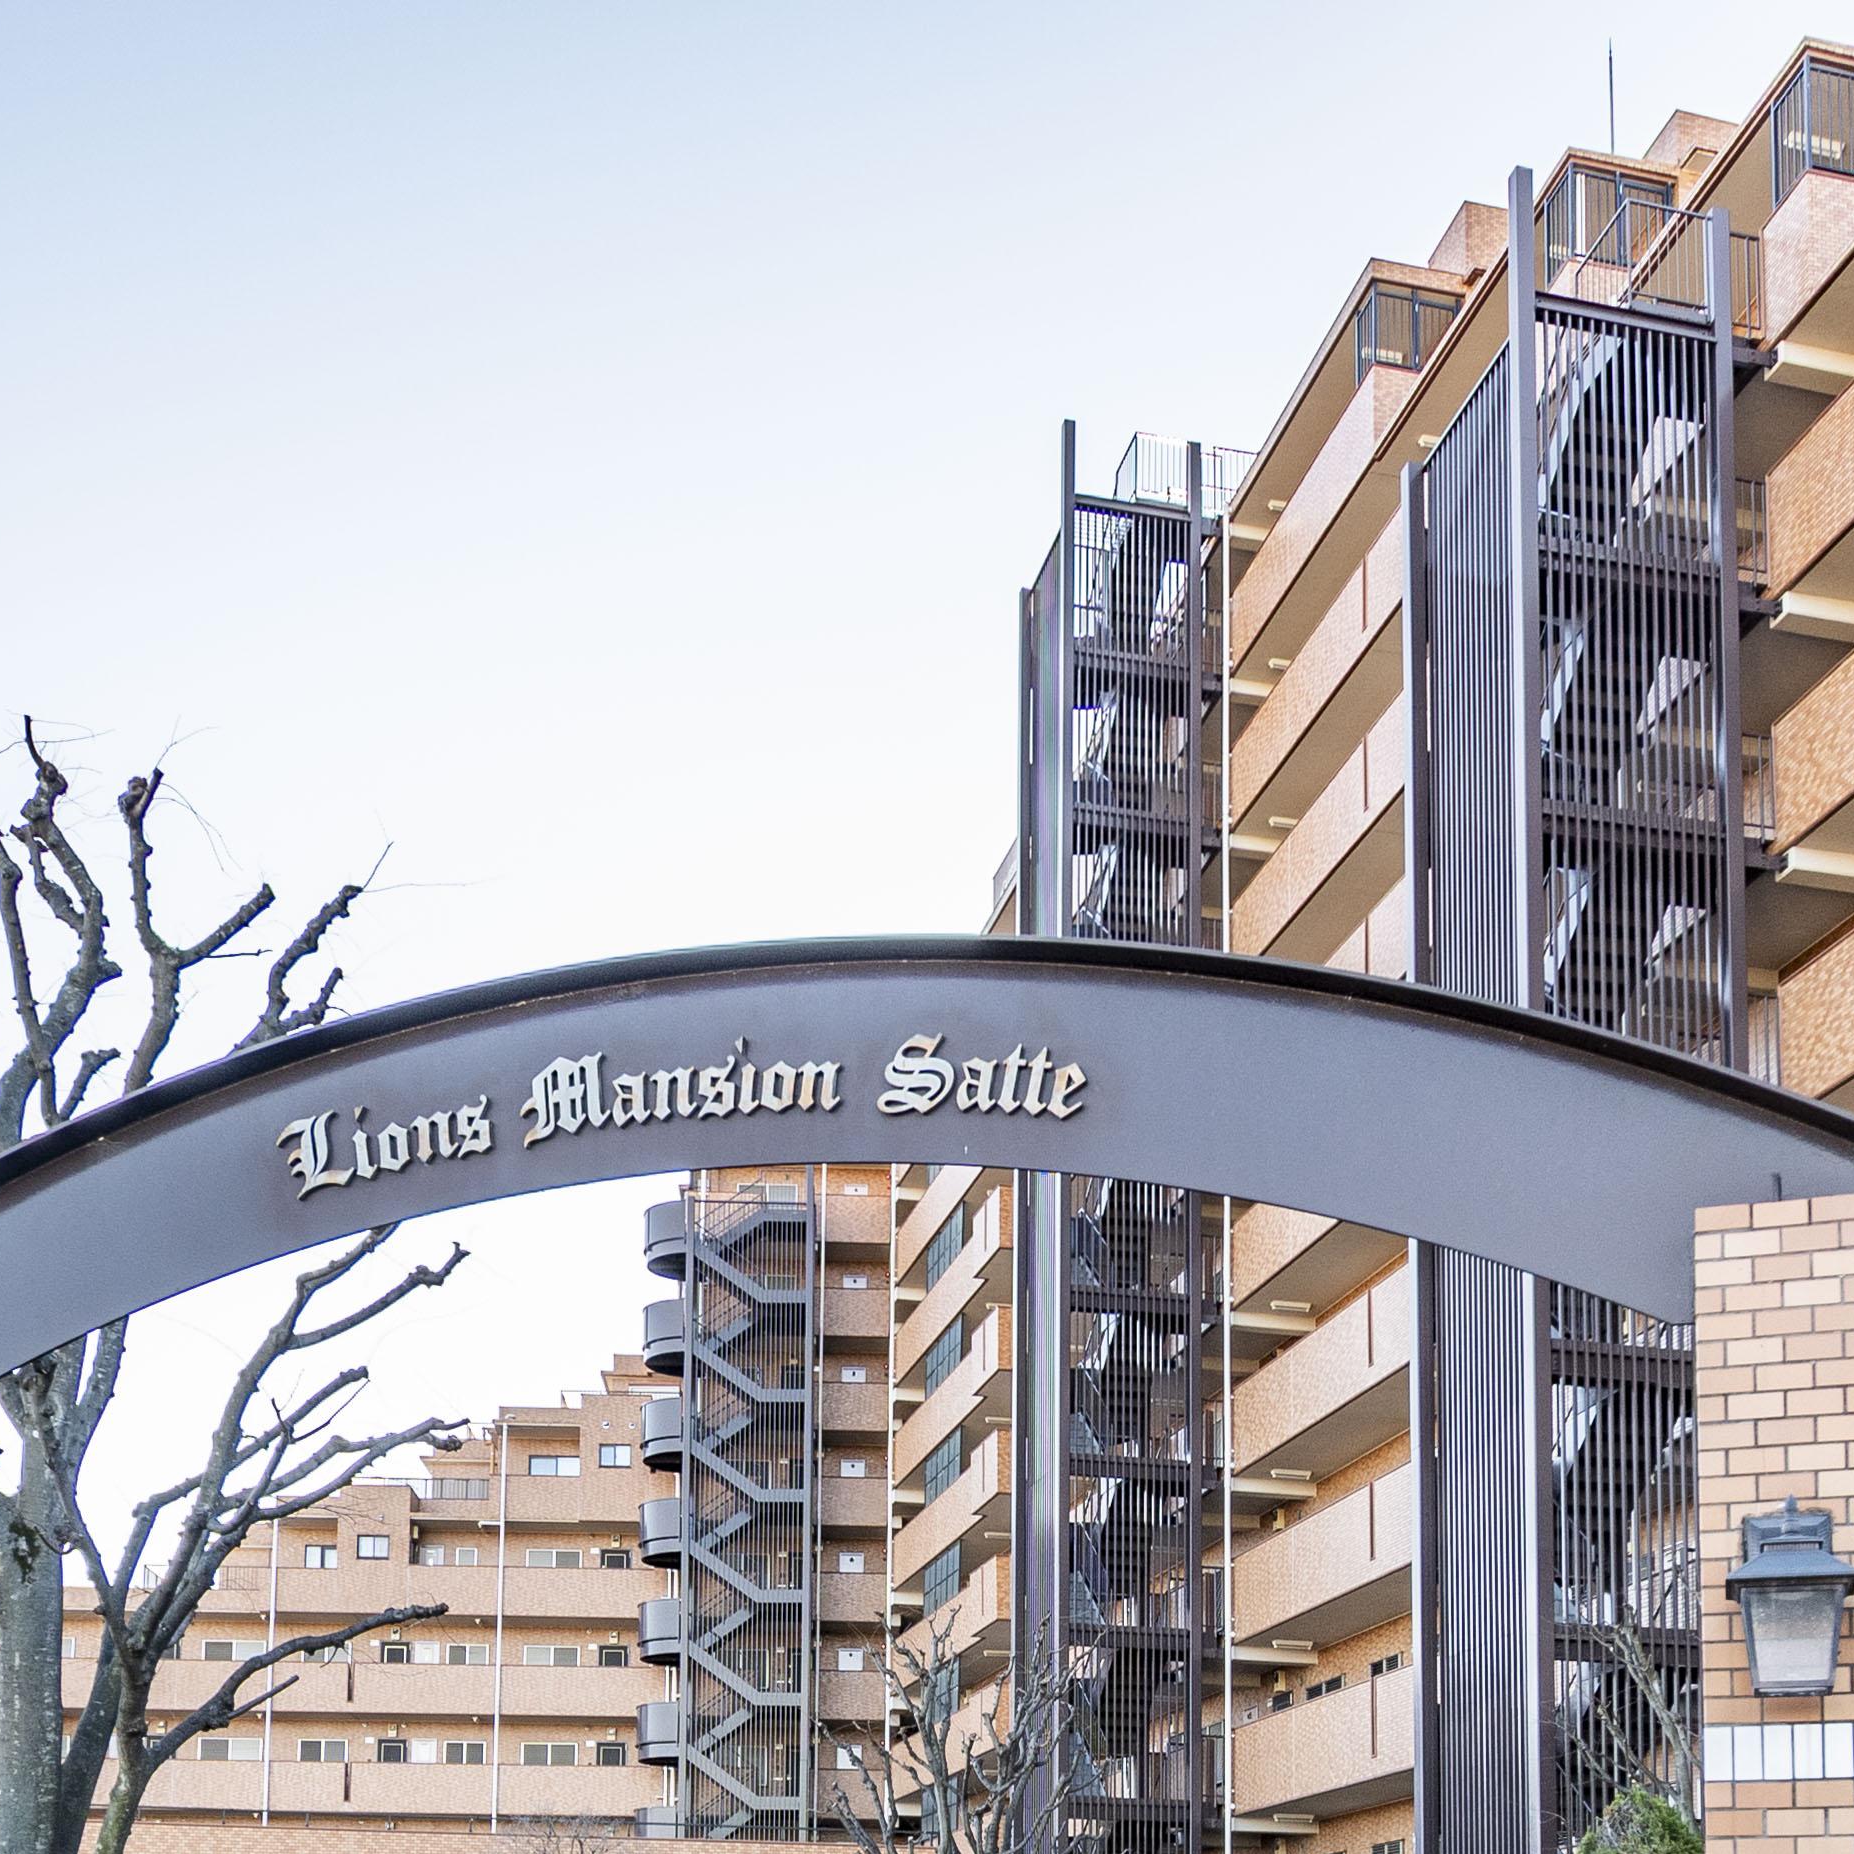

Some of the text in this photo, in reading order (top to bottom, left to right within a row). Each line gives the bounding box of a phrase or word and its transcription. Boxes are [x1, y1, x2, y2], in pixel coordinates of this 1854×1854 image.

[277, 1032, 1088, 1202] Lions Mansion Satte
